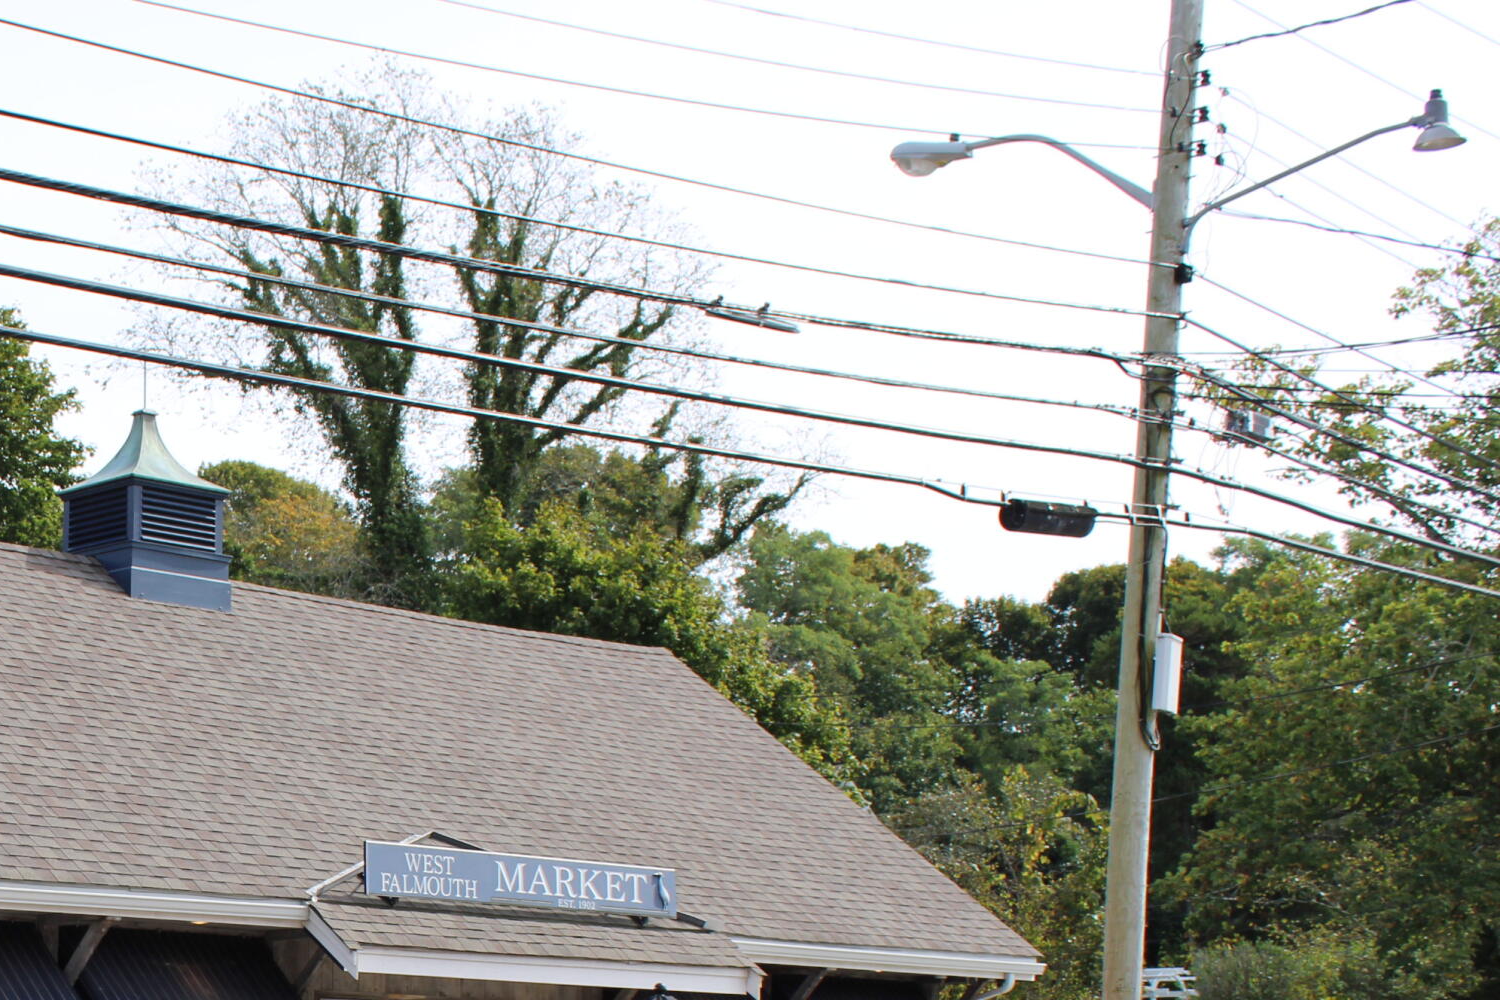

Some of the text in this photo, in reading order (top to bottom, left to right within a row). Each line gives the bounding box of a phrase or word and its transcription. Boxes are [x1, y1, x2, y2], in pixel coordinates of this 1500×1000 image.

[404, 852, 455, 876] WEST
[380, 871, 479, 899] FALMOUTH
[494, 860, 649, 904] MARKET
[558, 899, 577, 910] EST.
